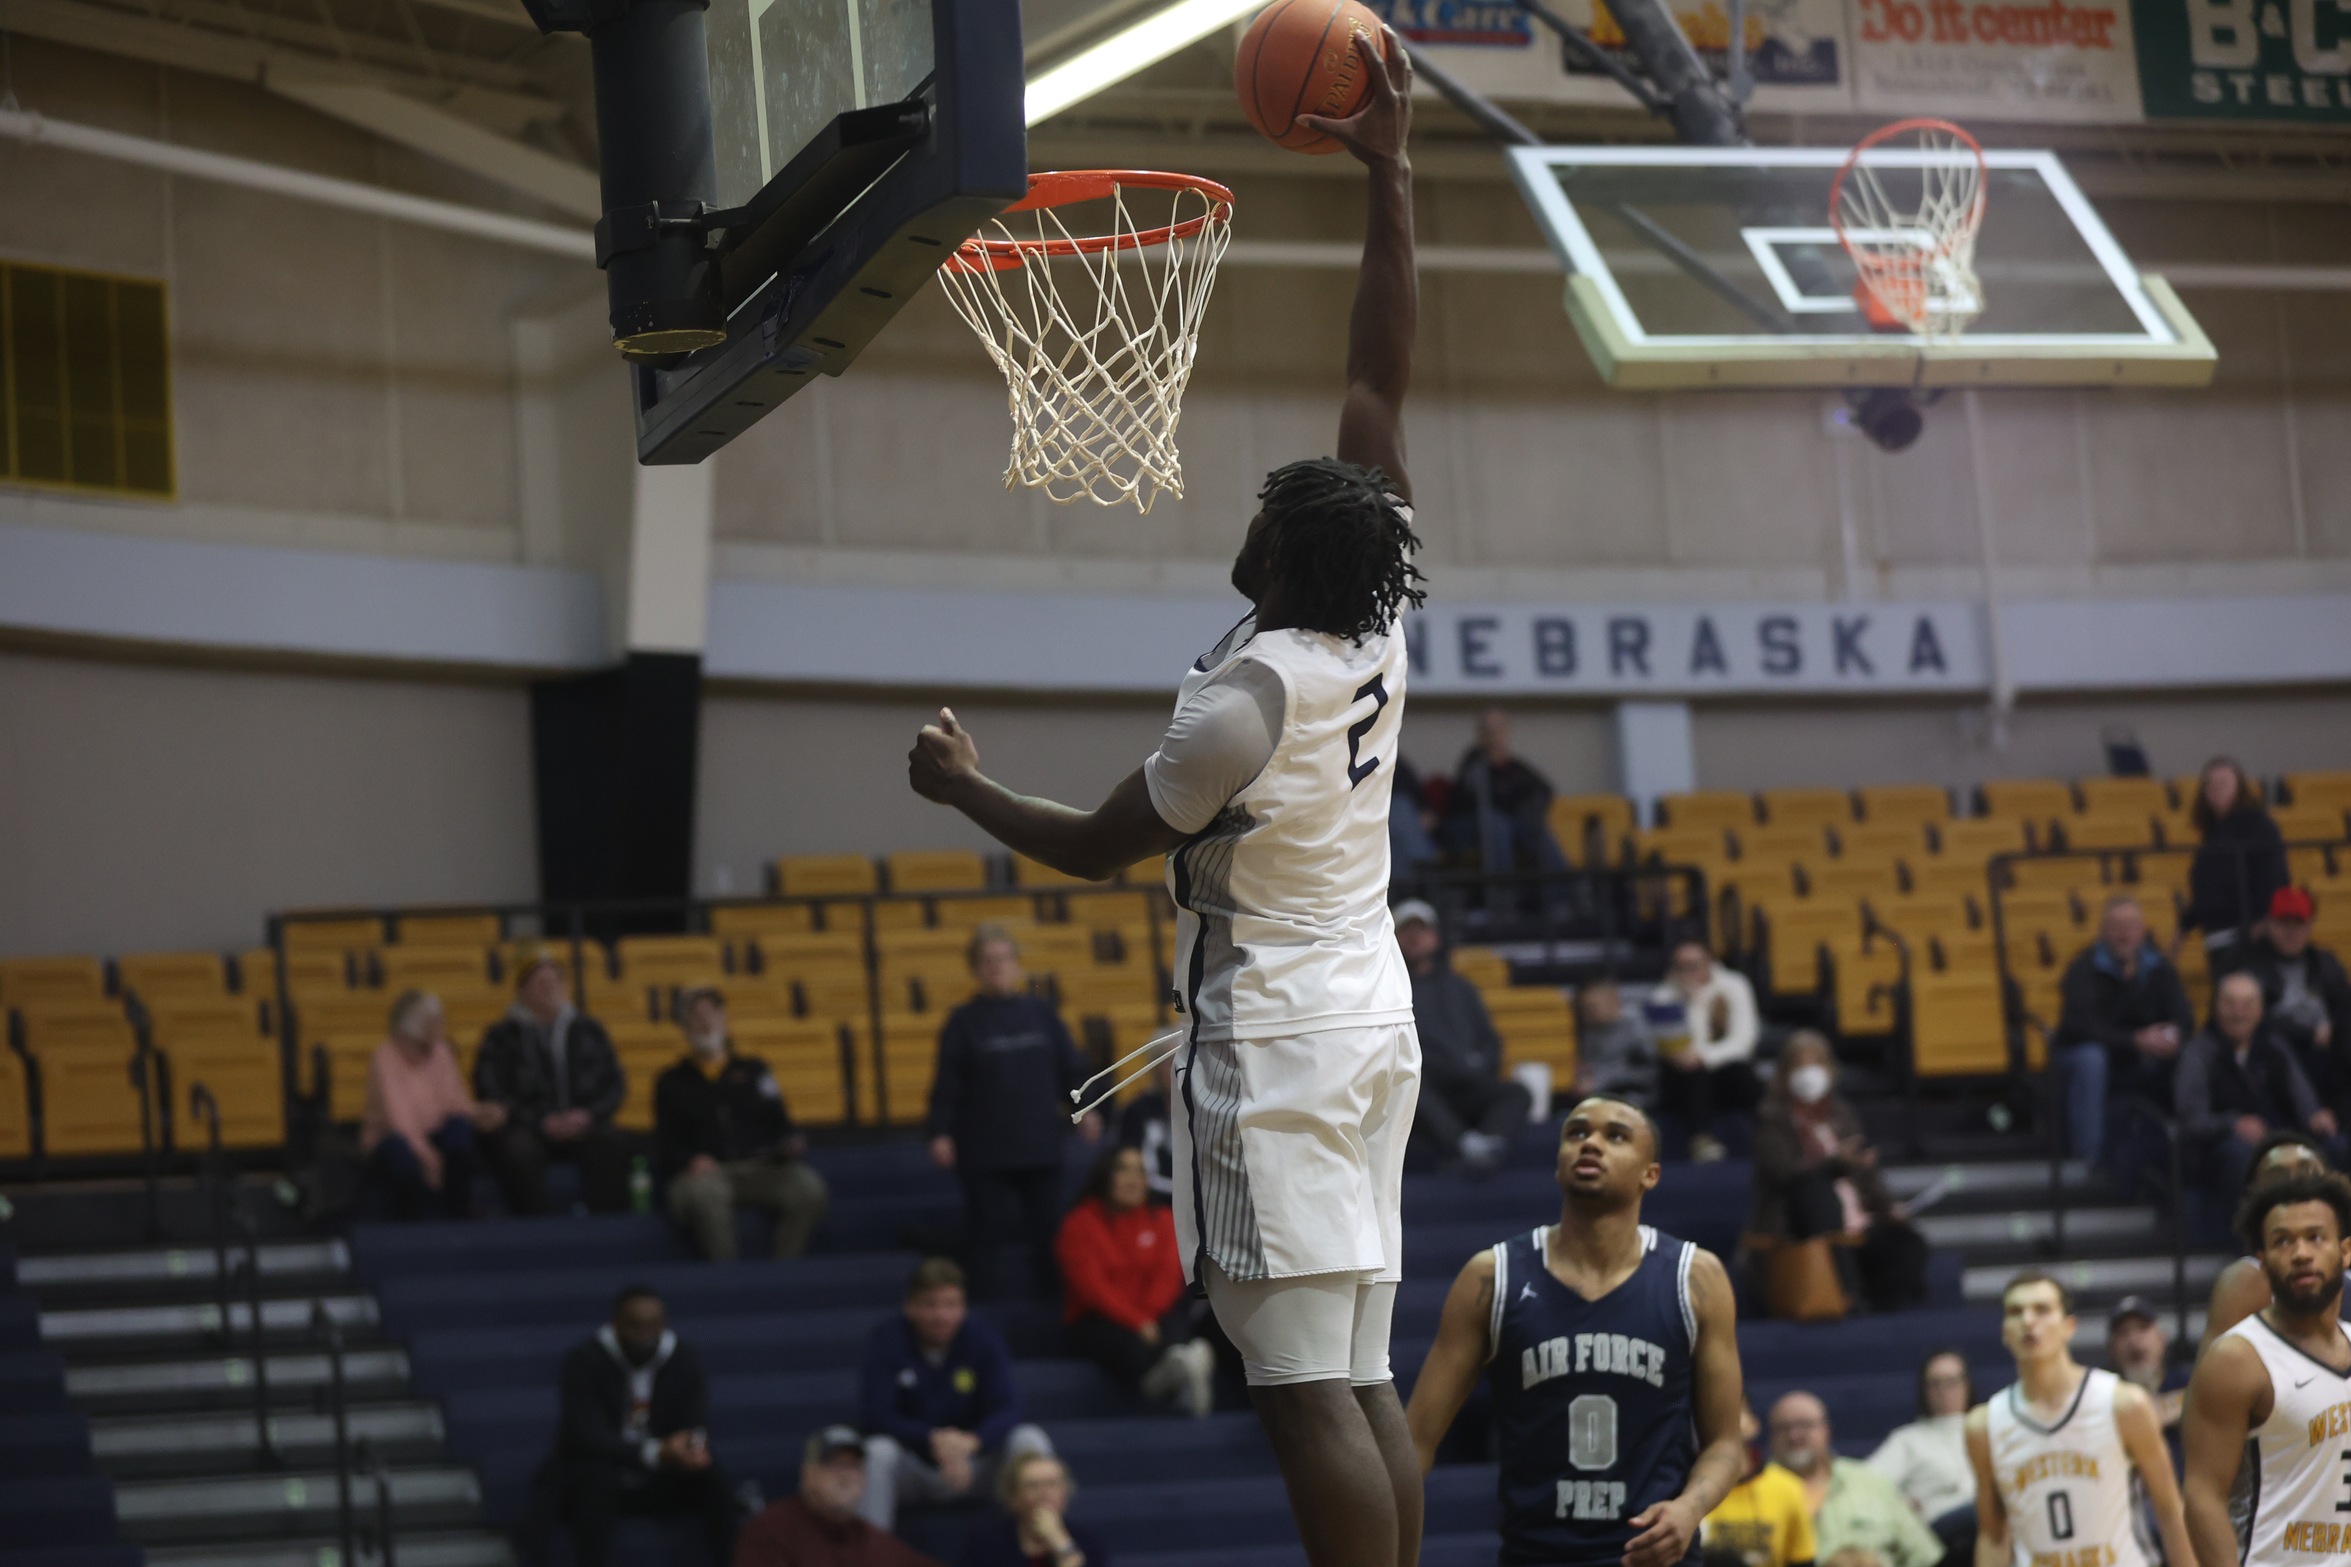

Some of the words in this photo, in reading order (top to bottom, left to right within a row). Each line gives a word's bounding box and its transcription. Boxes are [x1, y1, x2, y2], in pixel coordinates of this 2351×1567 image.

[1971, 0, 2117, 49] center
[1347, 672, 1389, 791] 2
[1522, 1336, 1569, 1390] AIR
[1574, 1332, 1666, 1388] FORCE
[1568, 1394, 1617, 1470] 0
[2308, 1402, 2351, 1447] WES
[1555, 1480, 1626, 1520] PREP
[2048, 1488, 2073, 1540] 0
